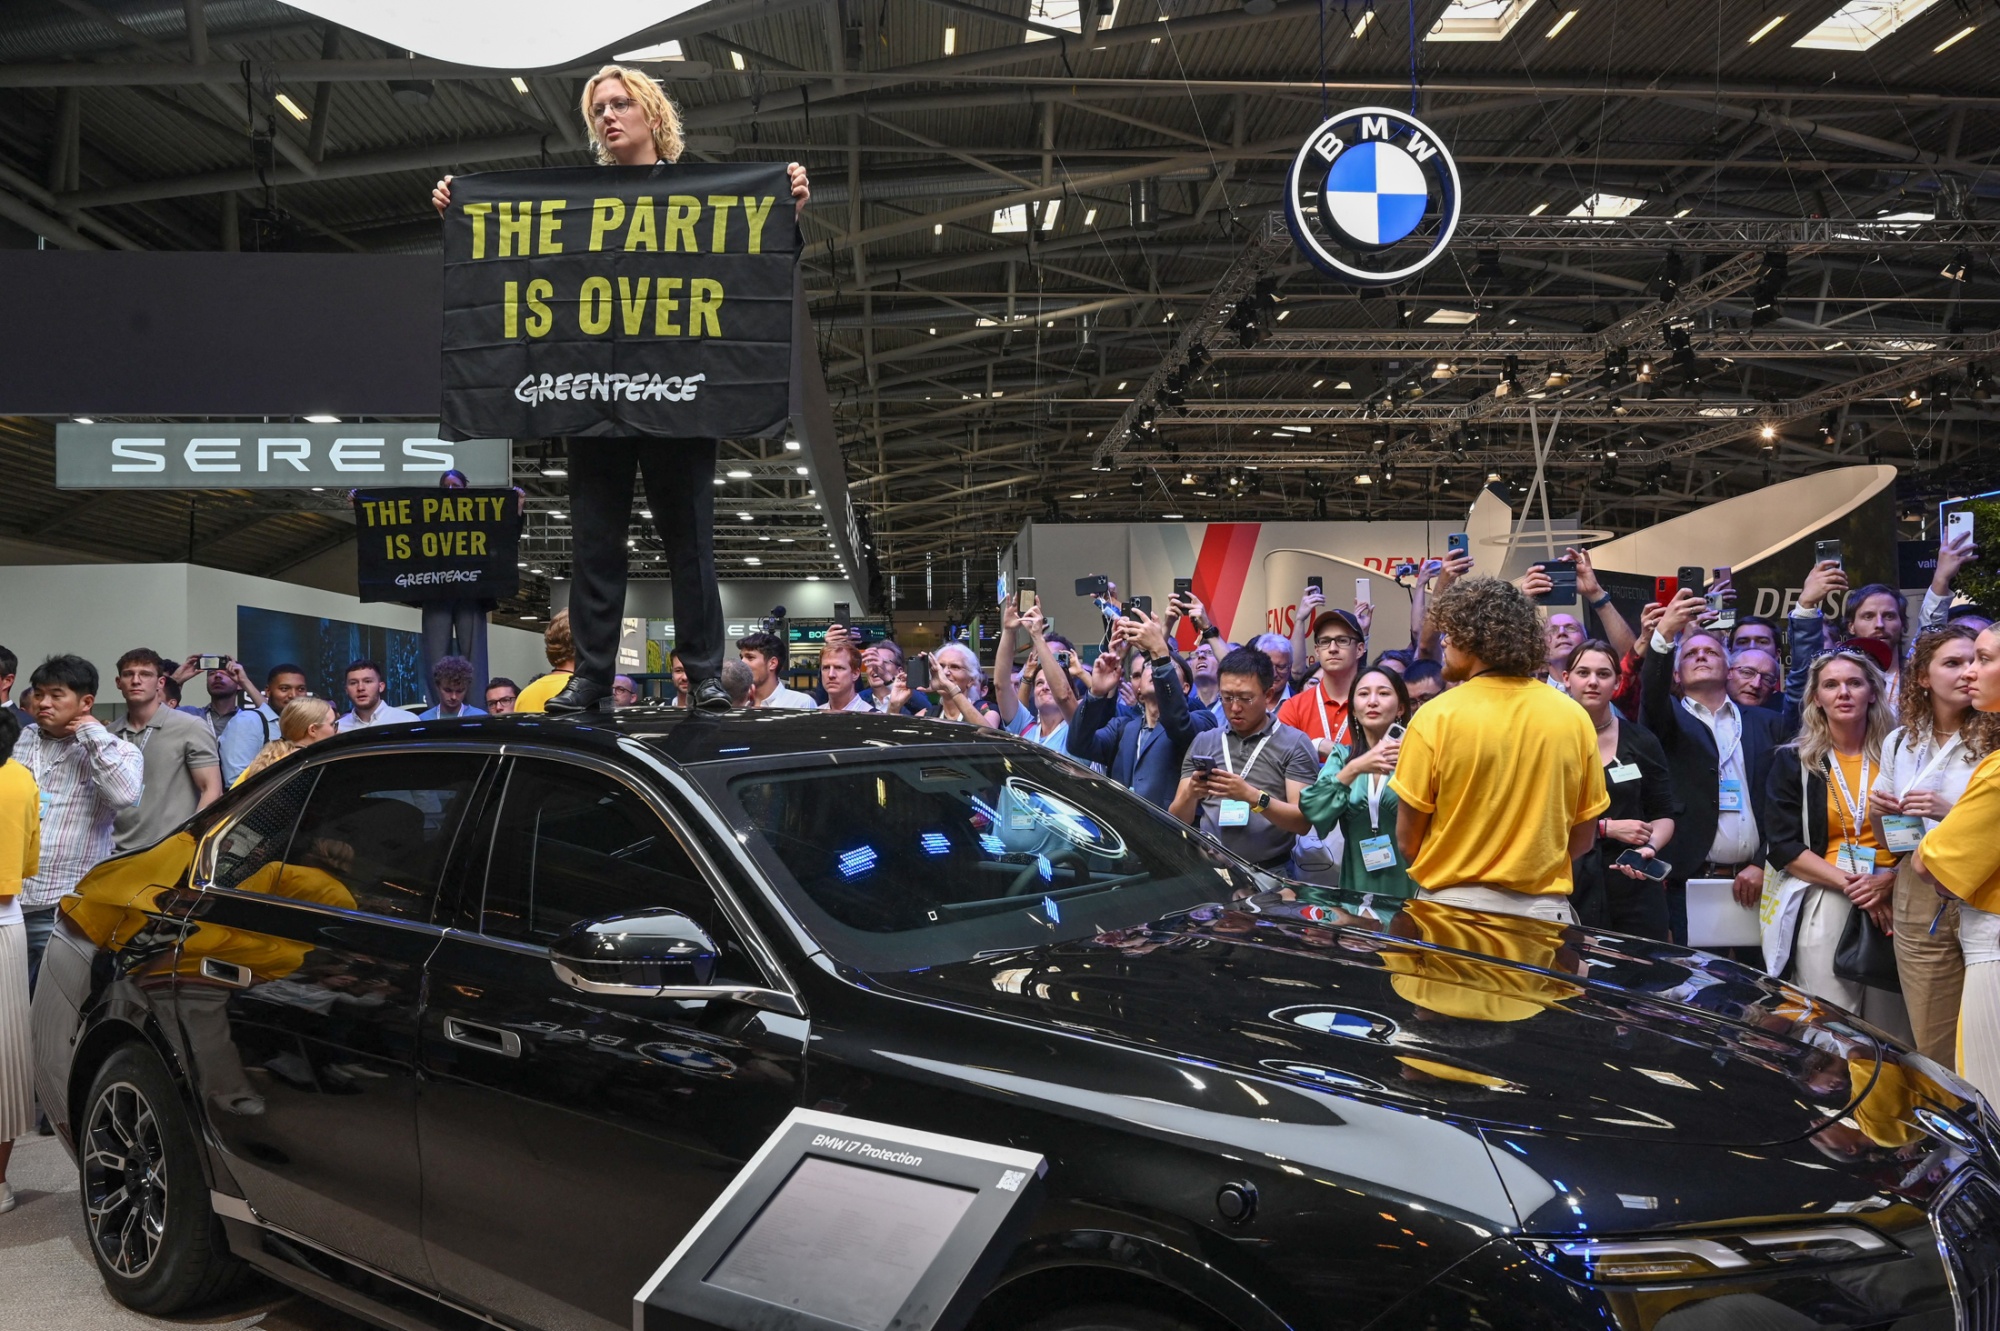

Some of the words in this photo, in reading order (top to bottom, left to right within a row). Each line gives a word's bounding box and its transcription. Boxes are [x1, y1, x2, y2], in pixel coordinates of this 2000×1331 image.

[1314, 116, 1438, 163] BMW
[463, 199, 566, 259] THE
[588, 195, 776, 255] PARTY
[504, 278, 553, 339] IS
[579, 275, 725, 337] OVER
[514, 372, 705, 408] GREENPEACE
[111, 437, 455, 473] SERES
[362, 498, 413, 528] THE
[423, 496, 506, 523] PARTY
[385, 534, 410, 560] IS
[421, 530, 487, 558] OVER
[394, 569, 482, 588] GREENPEACE
[812, 1134, 847, 1151] BMW
[845, 1140, 861, 1153] i7
[859, 1143, 923, 1166] Protection
